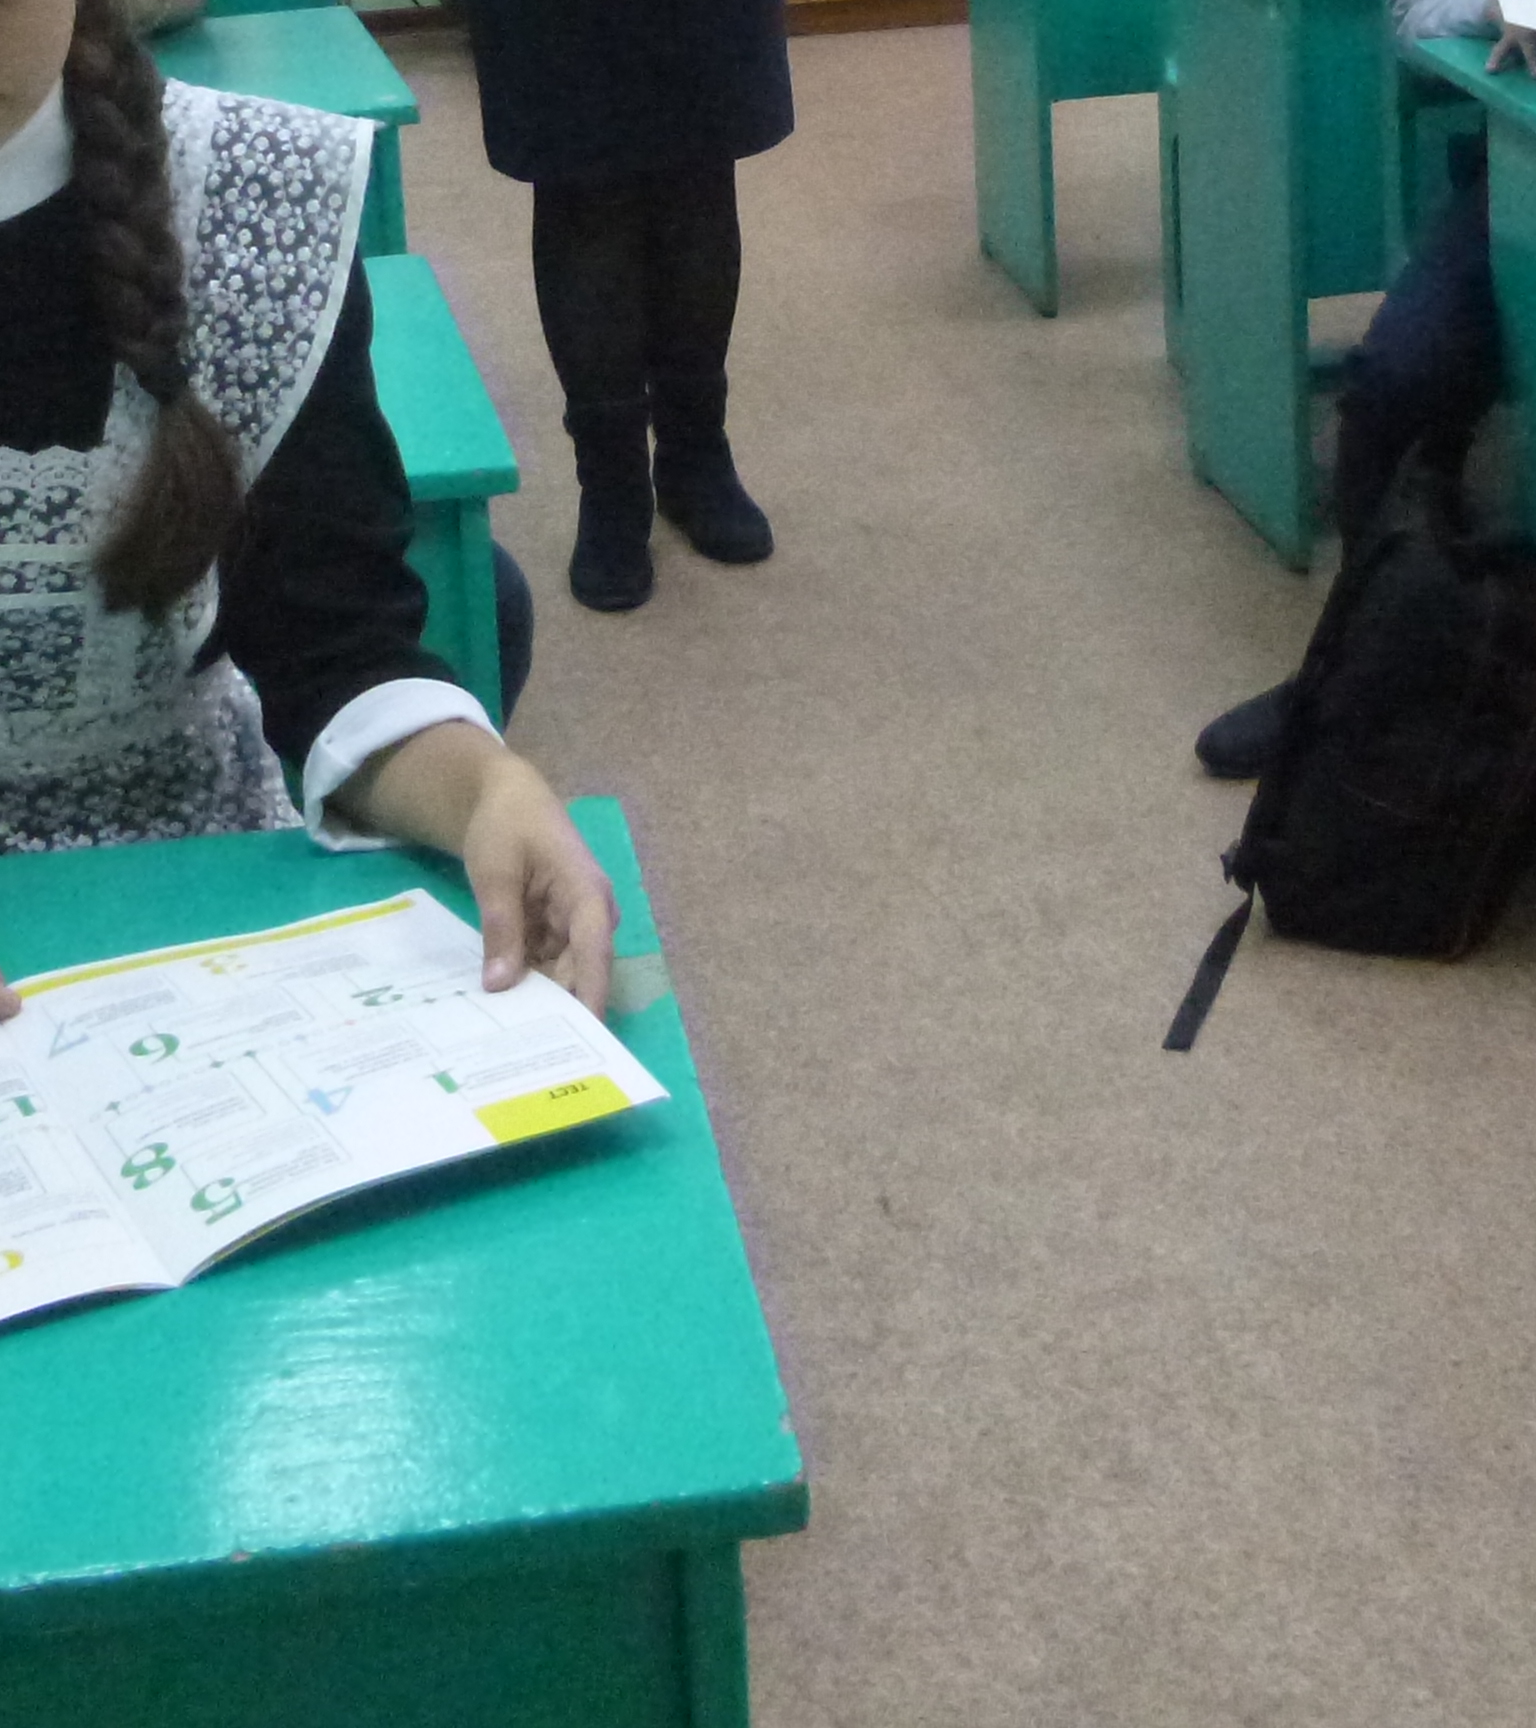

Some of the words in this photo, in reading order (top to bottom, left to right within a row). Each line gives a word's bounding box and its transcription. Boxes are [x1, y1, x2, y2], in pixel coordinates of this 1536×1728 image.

[351, 984, 404, 1007] 2
[128, 1032, 181, 1066] 6
[305, 1084, 354, 1116] 4
[547, 1082, 590, 1100] ТЕСТ
[119, 1140, 177, 1191] 8
[190, 1176, 244, 1225] 5
